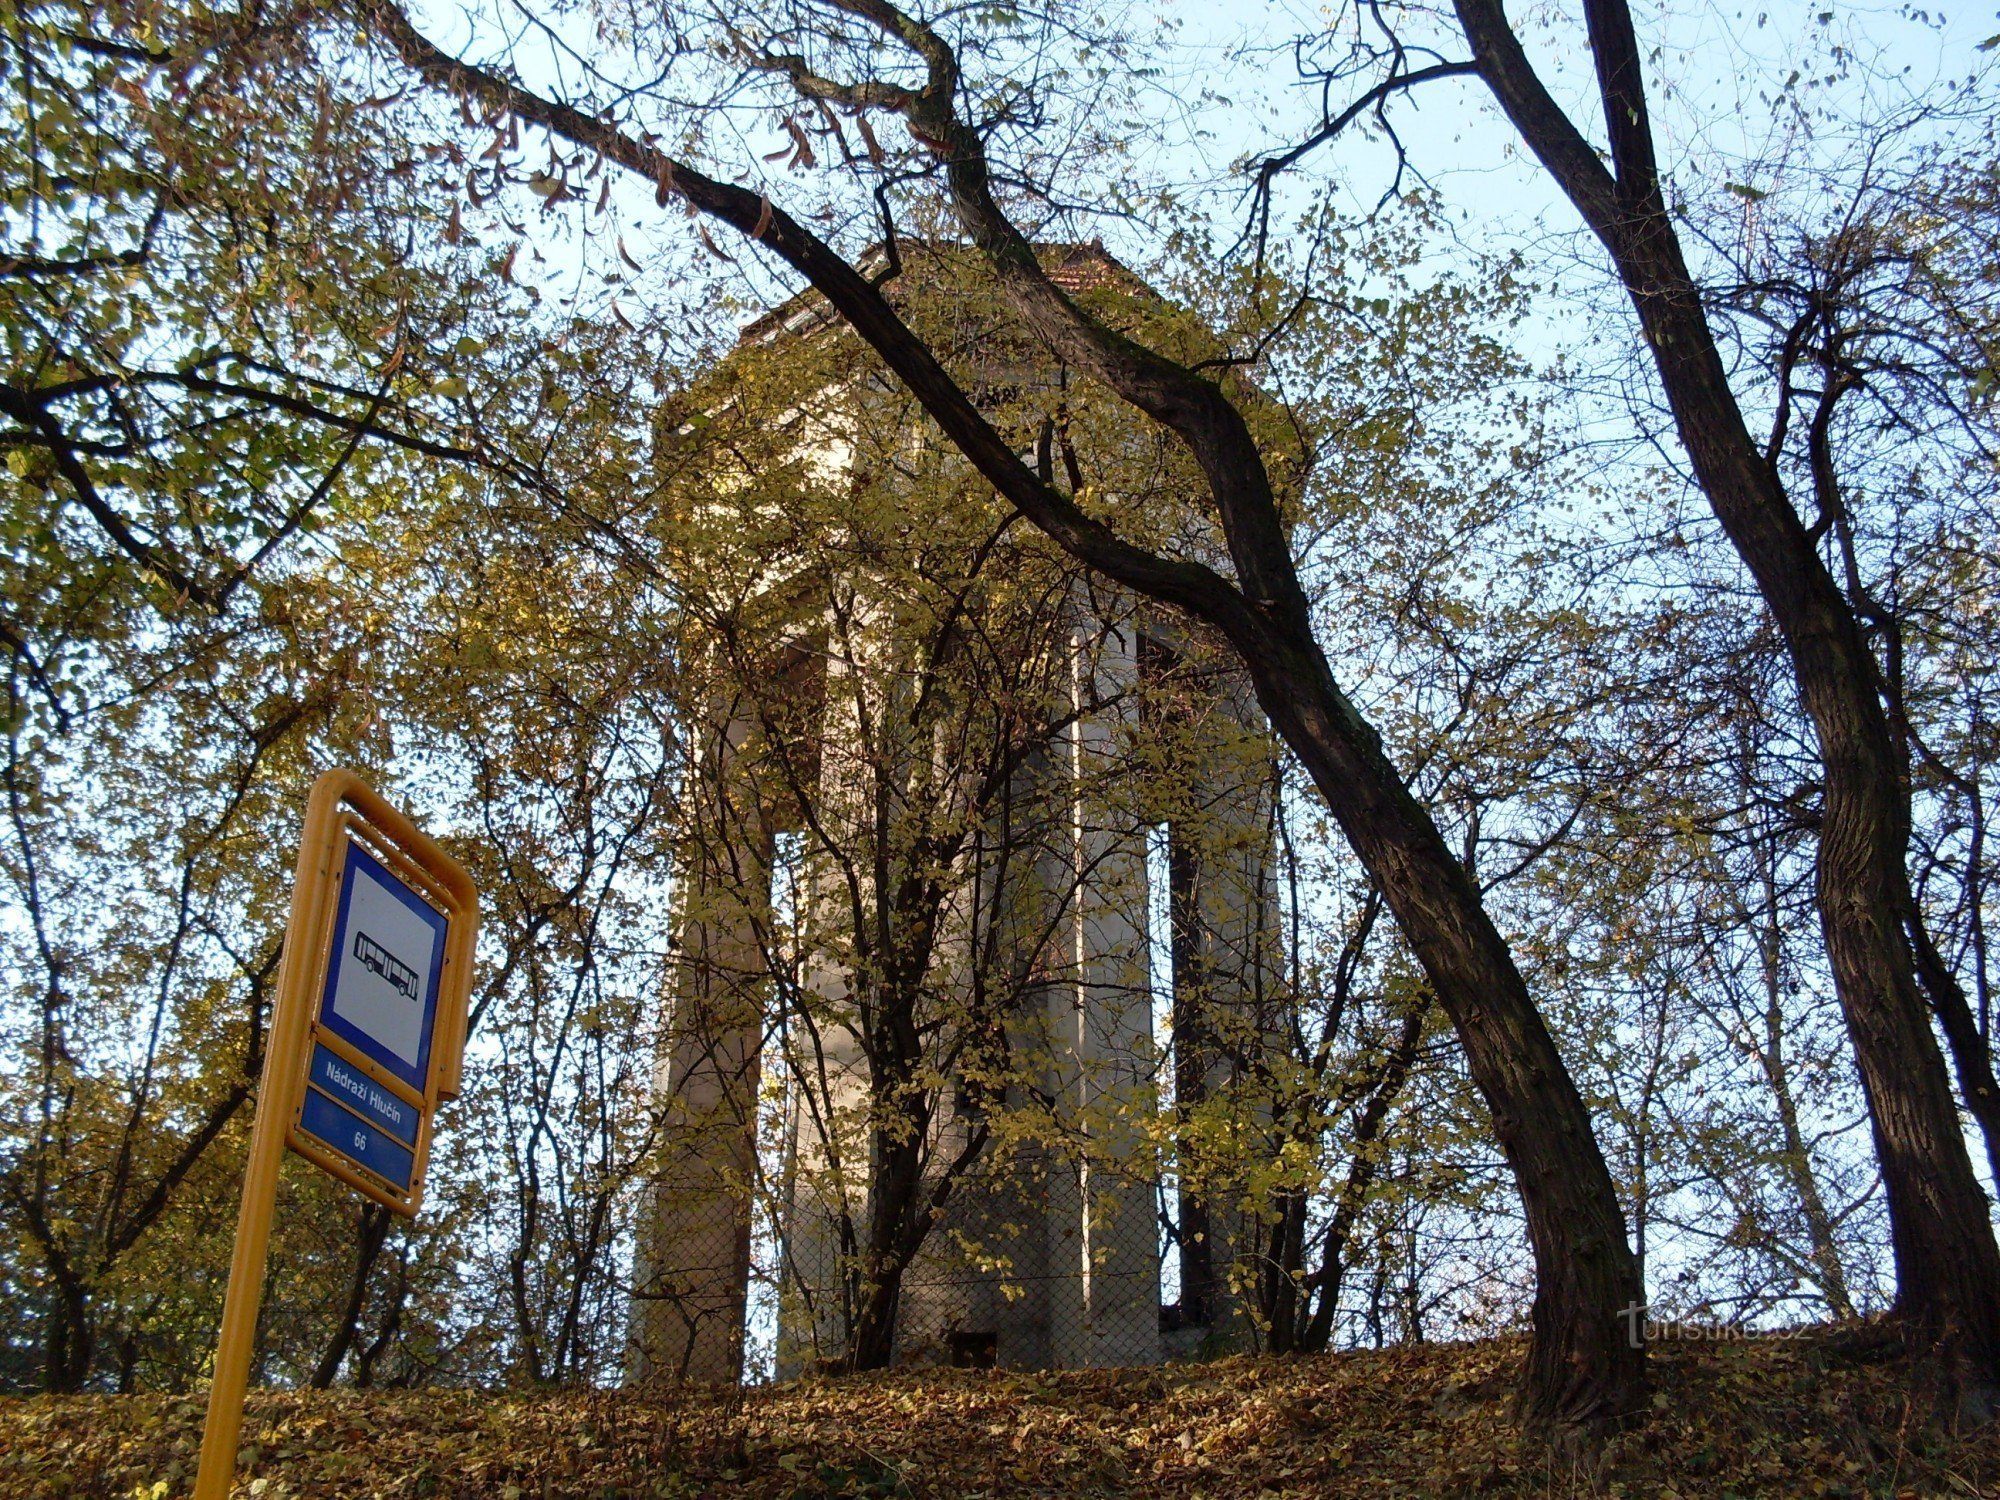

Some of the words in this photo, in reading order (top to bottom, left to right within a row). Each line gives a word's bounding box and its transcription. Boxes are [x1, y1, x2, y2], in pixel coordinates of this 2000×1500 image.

[326, 1061, 367, 1100] Nádraží
[369, 1091, 401, 1123] Hlučín
[354, 1131, 366, 1150] 66
